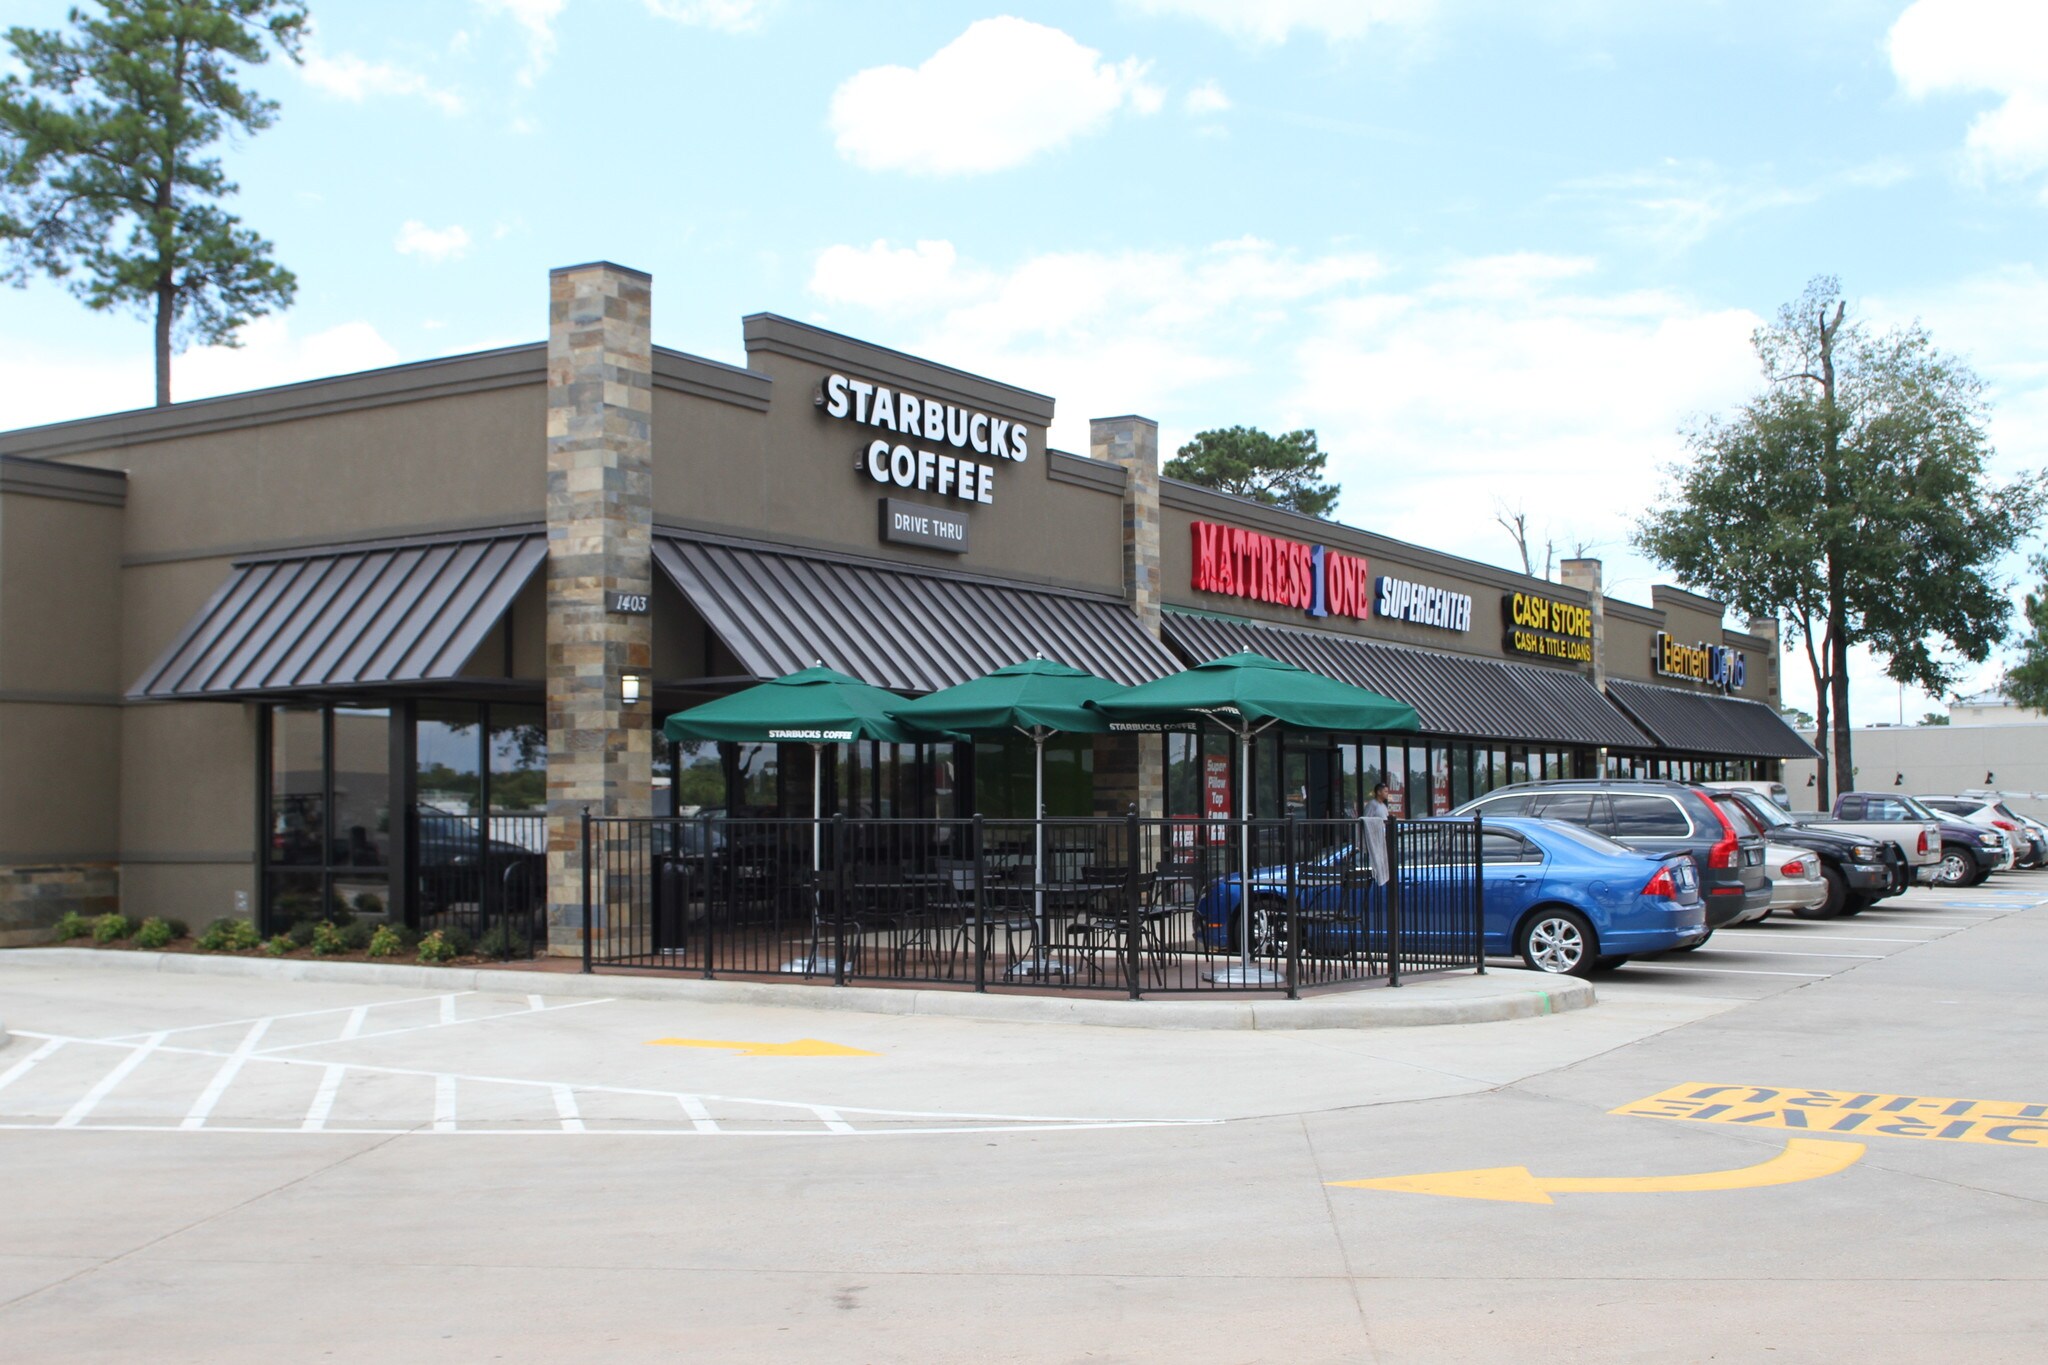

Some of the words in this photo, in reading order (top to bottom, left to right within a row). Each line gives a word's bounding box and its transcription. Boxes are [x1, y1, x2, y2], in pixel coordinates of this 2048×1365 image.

[826, 373, 1028, 463] STARBUCKS
[868, 439, 994, 505] COFFEE
[894, 513, 929, 535] DRIVE
[932, 520, 963, 541] THRU
[1197, 520, 1312, 611] MATTRESS
[1328, 550, 1368, 621] ONE
[616, 594, 648, 612] 1403
[1379, 575, 1472, 632] SUPERCENTER
[1513, 592, 1549, 630] CASH
[1551, 601, 1592, 638] STORE
[1514, 630, 1538, 653] CASH
[1539, 635, 1545, 655] &
[1545, 637, 1567, 657] TITLE
[1567, 641, 1591, 662] LOANS
[768, 729, 822, 739] STARBUCKS
[823, 730, 853, 740] COFFEE
[1109, 722, 1162, 731] STARBUCKS
[1163, 722, 1198, 731] COFFEE
[1211, 791, 1224, 808] Top
